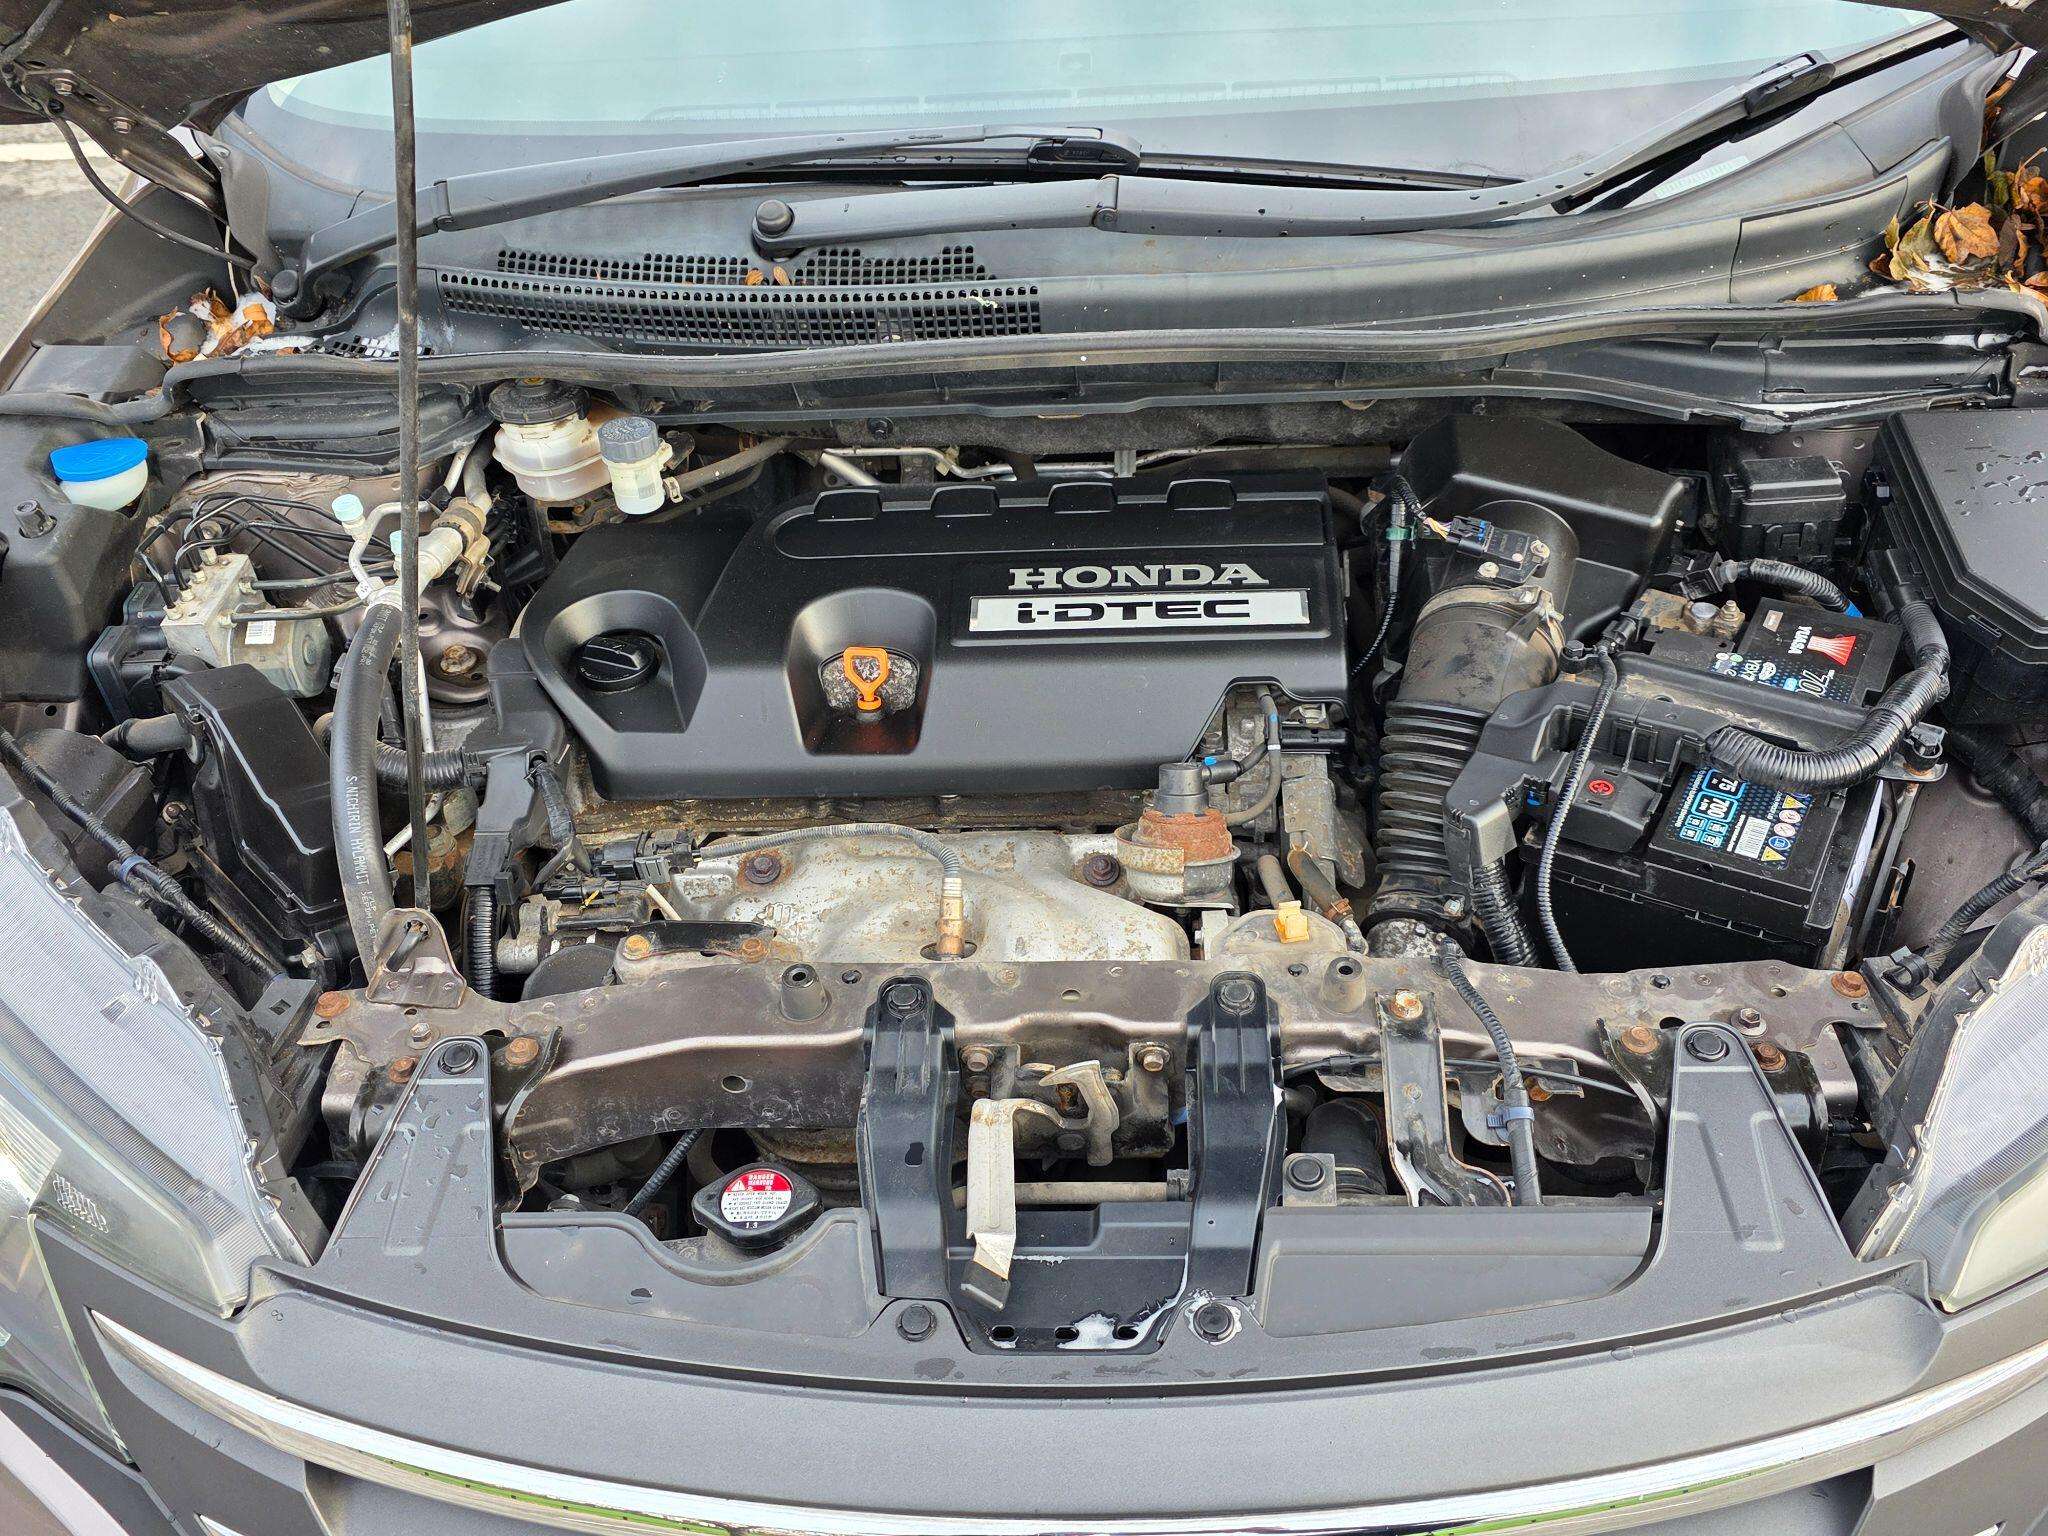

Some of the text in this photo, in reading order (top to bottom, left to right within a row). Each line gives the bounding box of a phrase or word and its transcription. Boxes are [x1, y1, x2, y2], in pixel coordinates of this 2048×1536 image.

[1008, 563, 1269, 591] HONDA
[1018, 600, 1250, 624] i-DTEC
[1788, 626, 1812, 653] YUASA
[1795, 670, 1830, 698] 70
[1719, 778, 1738, 792] 75
[1707, 798, 1730, 818] 700
